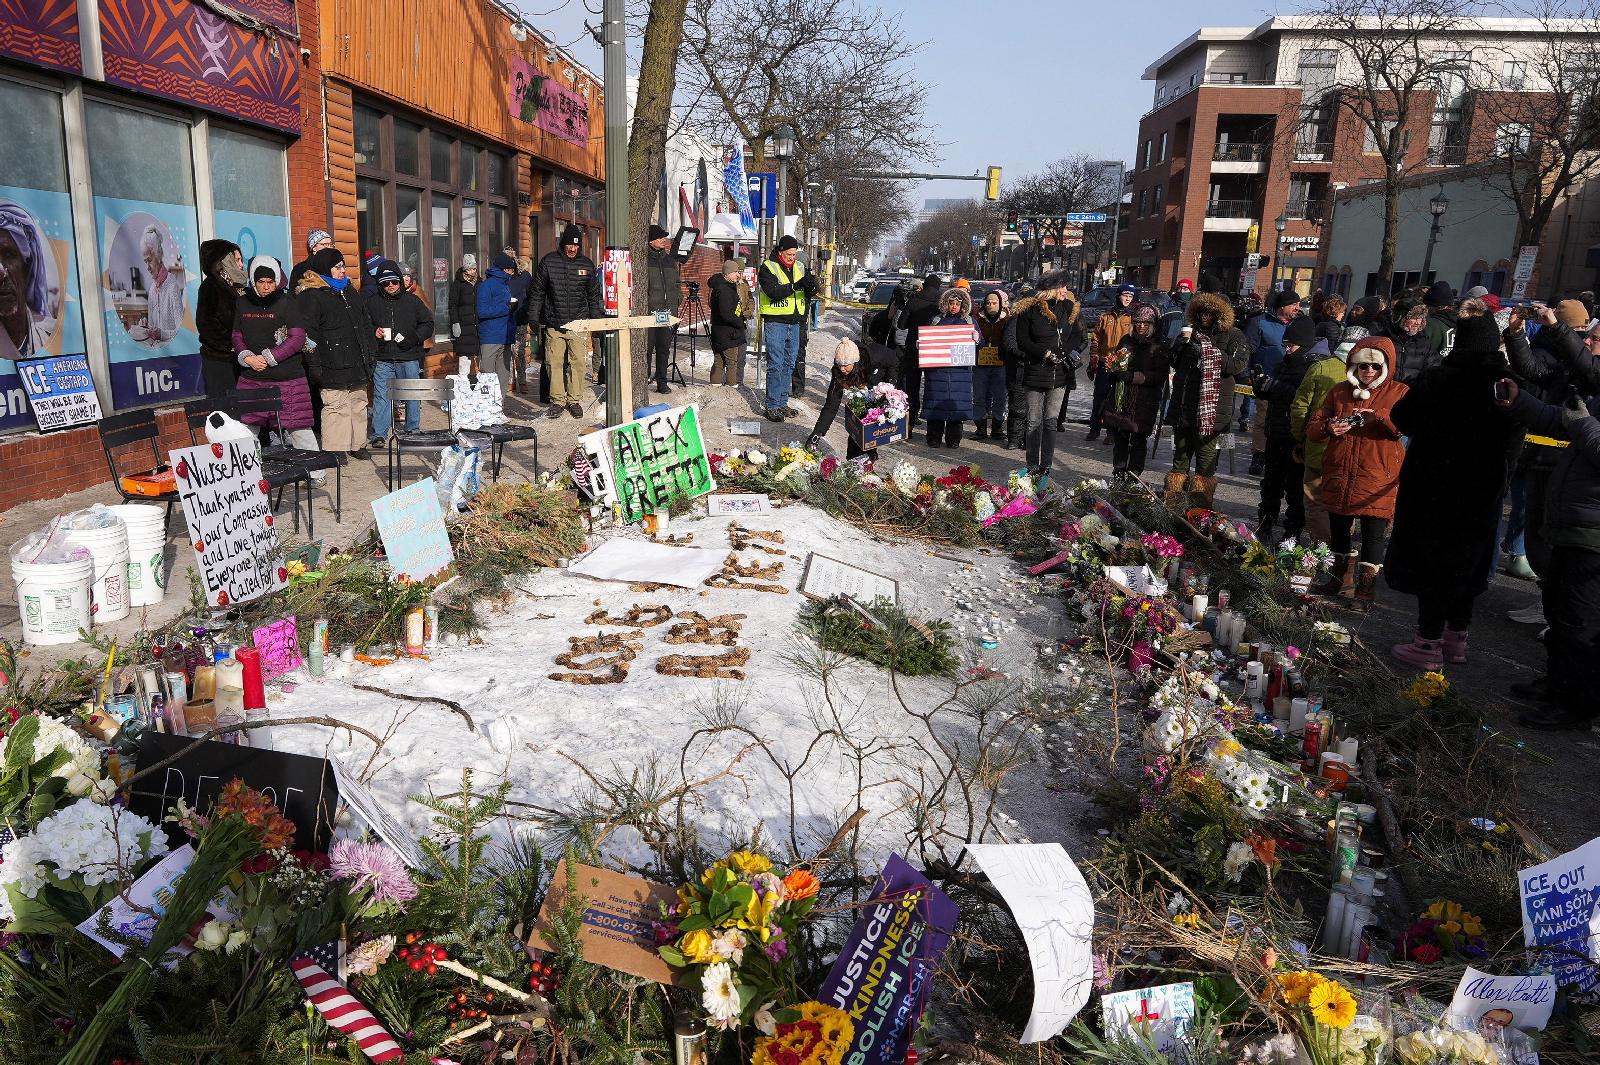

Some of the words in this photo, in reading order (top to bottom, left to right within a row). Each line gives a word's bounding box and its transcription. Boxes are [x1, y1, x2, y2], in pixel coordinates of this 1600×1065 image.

[1307, 236, 1320, 244] Up
[605, 261, 632, 272] DON
[769, 299, 789, 308] PRESS
[952, 355, 973, 365] OUT
[953, 345, 970, 355] ICE
[20, 364, 52, 394] ICE
[52, 359, 88, 374] AMERICAN
[135, 366, 180, 396] Inc.
[35, 400, 51, 412] THEY
[63, 395, 72, 406] BE
[74, 394, 88, 404] OUR
[617, 413, 689, 468] ALEX
[180, 451, 228, 490] Nurse
[227, 441, 260, 479] Alex
[183, 489, 225, 519] Thank
[224, 491, 241, 514] you
[202, 549, 224, 567] and
[226, 539, 250, 559] Love
[205, 557, 254, 592] Everyone
[1523, 872, 1551, 895] ICE
[1558, 865, 1586, 890] OUT
[591, 899, 606, 909] Call
[615, 905, 631, 916] chat
[608, 894, 628, 905] Have
[1532, 897, 1547, 909] OF
[1533, 904, 1564, 924] MNI
[1566, 892, 1594, 914] SÓTA
[832, 902, 894, 1011] JUSTICE.
[849, 890, 922, 1022] KINDNESS.
[1111, 995, 1130, 1005] Alex
[1463, 976, 1510, 1004] Alex
[847, 971, 903, 1065] BOLISH
